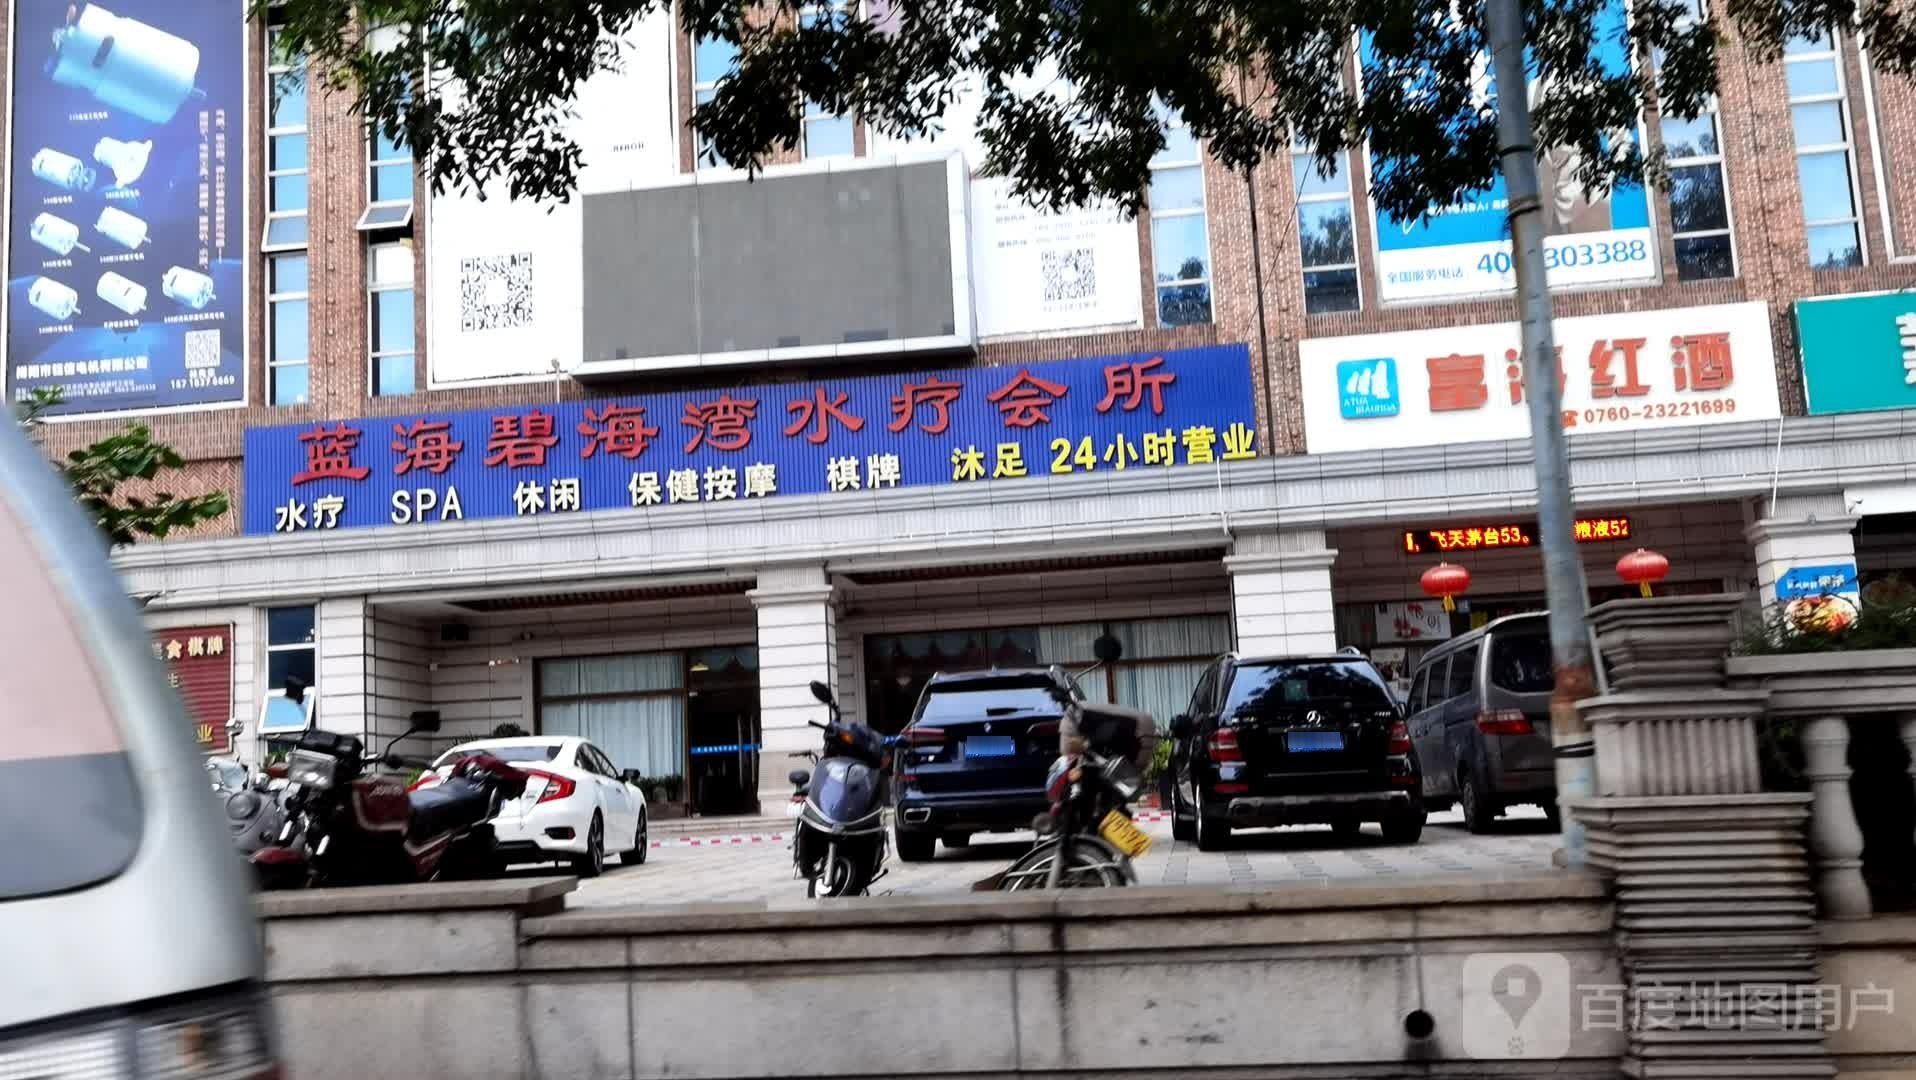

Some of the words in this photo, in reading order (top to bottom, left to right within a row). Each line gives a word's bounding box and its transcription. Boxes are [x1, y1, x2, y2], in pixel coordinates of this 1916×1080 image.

[1476, 239, 1647, 275] 40303388
[291, 356, 1177, 486] 蓝海碧海湾水疗会所
[1585, 399, 1737, 424] 0760-23221699
[275, 494, 346, 533] 水疗
[391, 485, 464, 525] SPA
[513, 477, 582, 516] 休闲
[628, 462, 778, 507] 保健按摩
[826, 453, 902, 492] 棋牌
[950, 442, 1029, 483] 沐足
[1050, 422, 1258, 475] 24小时营业
